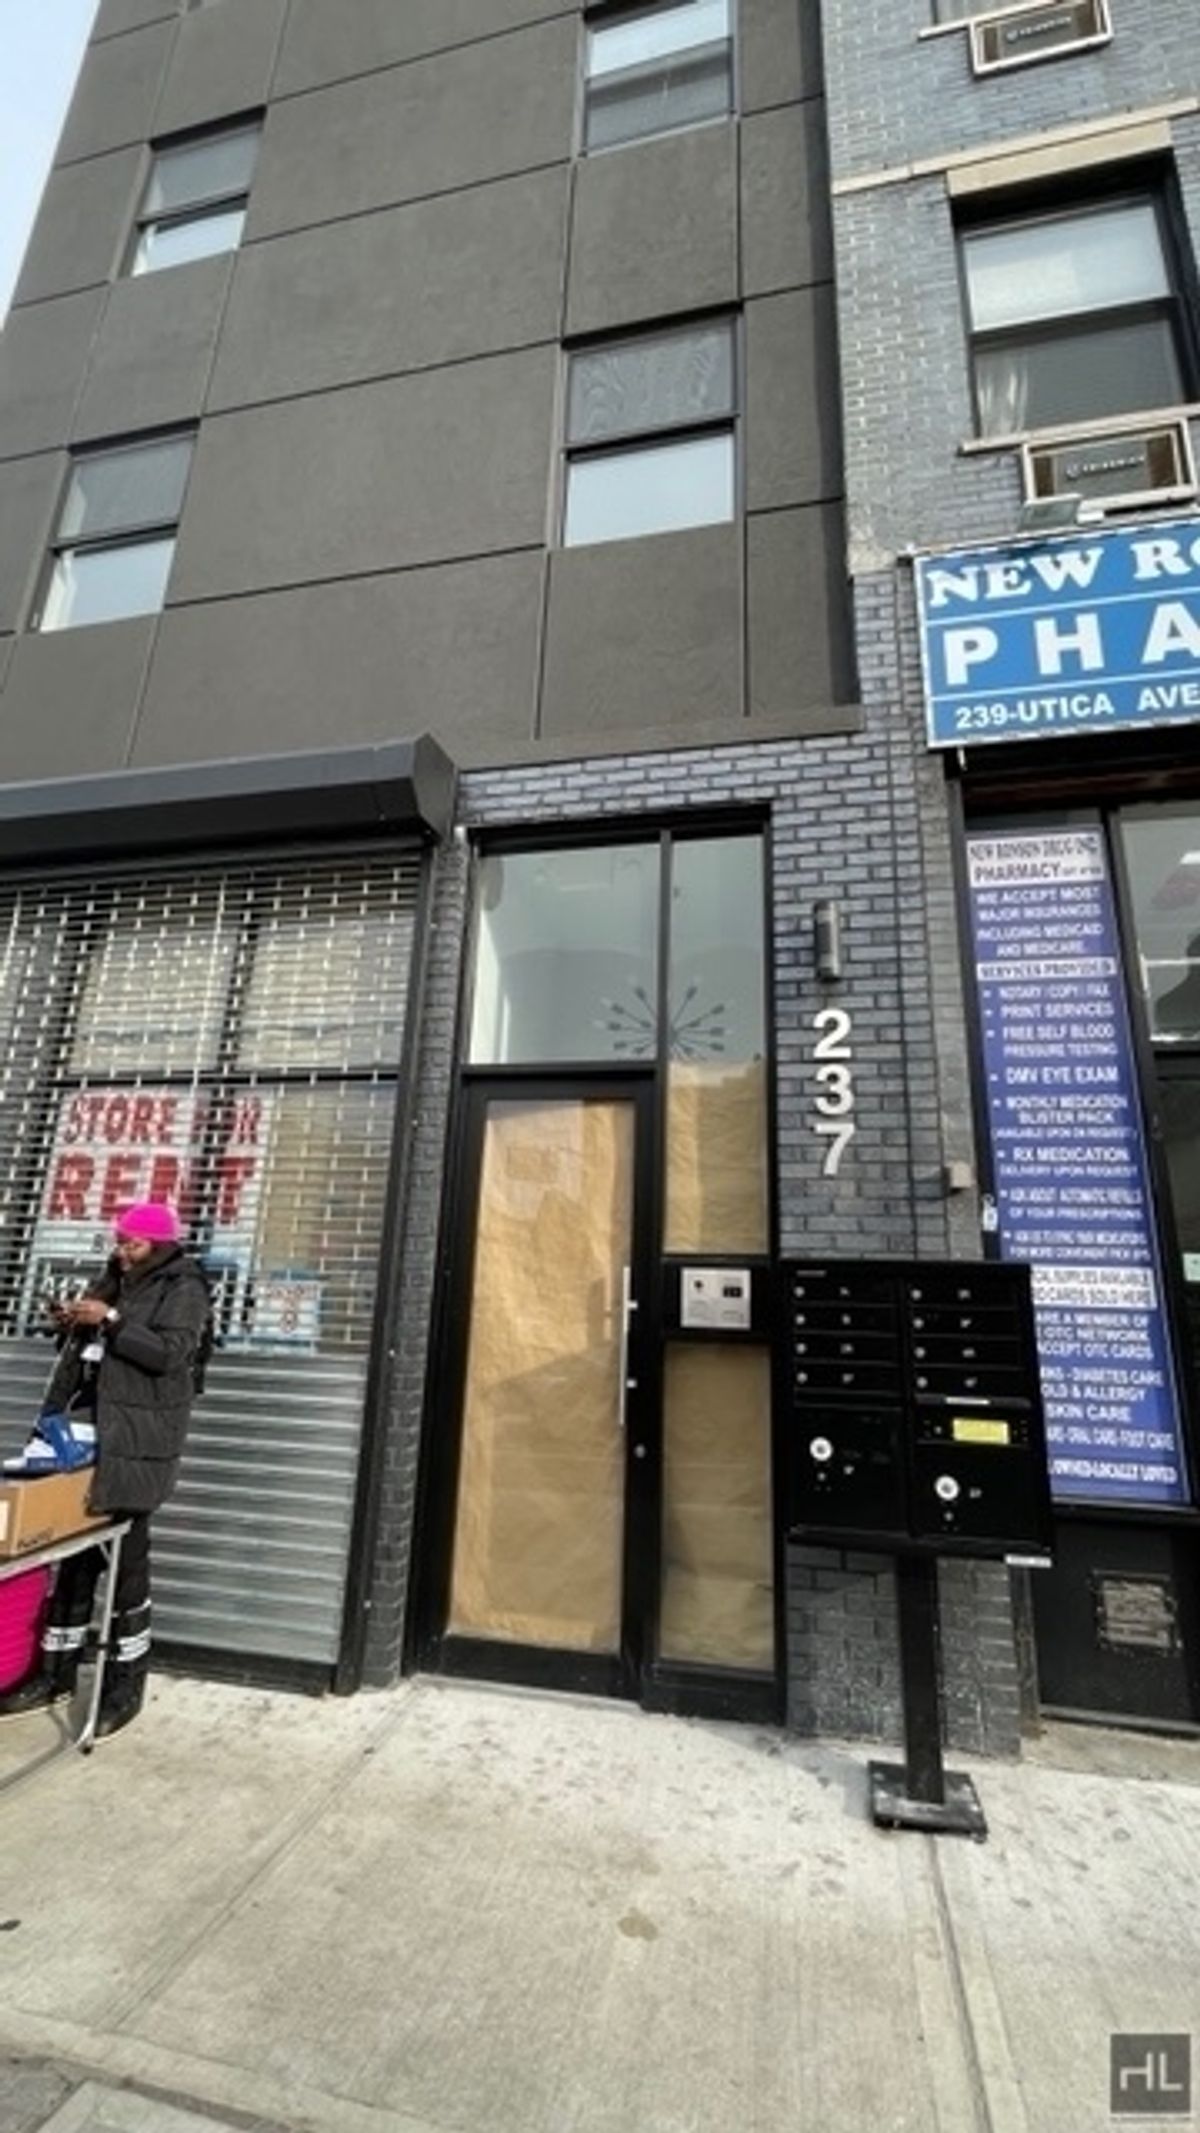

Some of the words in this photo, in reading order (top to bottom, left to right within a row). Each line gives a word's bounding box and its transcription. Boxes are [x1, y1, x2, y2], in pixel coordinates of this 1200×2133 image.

[926, 547, 1103, 607] NEW
[956, 693, 1114, 729] 239-UTICA
[975, 863, 1062, 883] PHARMACY
[976, 892, 998, 905] WE
[1001, 888, 1058, 904] ACCEPT
[1060, 886, 1100, 900] MOST
[978, 908, 1021, 922] MAJOR
[1023, 904, 1102, 919] INSURANCES
[976, 925, 1042, 940] INCLUDING
[1044, 923, 1104, 938] MEDICAID
[996, 942, 1021, 956] AND
[1023, 940, 1085, 955] MEDICARE
[981, 962, 1041, 977] SERVICES
[999, 986, 1041, 999] NOTARY
[1001, 1004, 1041, 1018] PRINT
[1045, 1002, 1114, 1017] SERVICES
[1003, 1024, 1034, 1040] FREE
[1037, 1024, 1067, 1039] SELF
[1070, 1023, 1115, 1039] BLOOD
[1003, 1043, 1065, 1056] PRESSURE
[1067, 1042, 1118, 1056] TESTING
[1006, 1066, 1038, 1084] DMV
[1043, 1066, 1071, 1084] EYE
[1074, 1066, 1119, 1083] EXAM
[64, 1095, 177, 1142] STORE
[1013, 1147, 1034, 1162] RX
[1037, 1147, 1131, 1162] MEDICATION
[47, 1154, 258, 1224] RENT
[1077, 1329, 1149, 1342] NETWORK
[1041, 1384, 1068, 1398] OLD
[1084, 1386, 1146, 1401] ALLERGY
[1086, 1405, 1131, 1421] CARE
